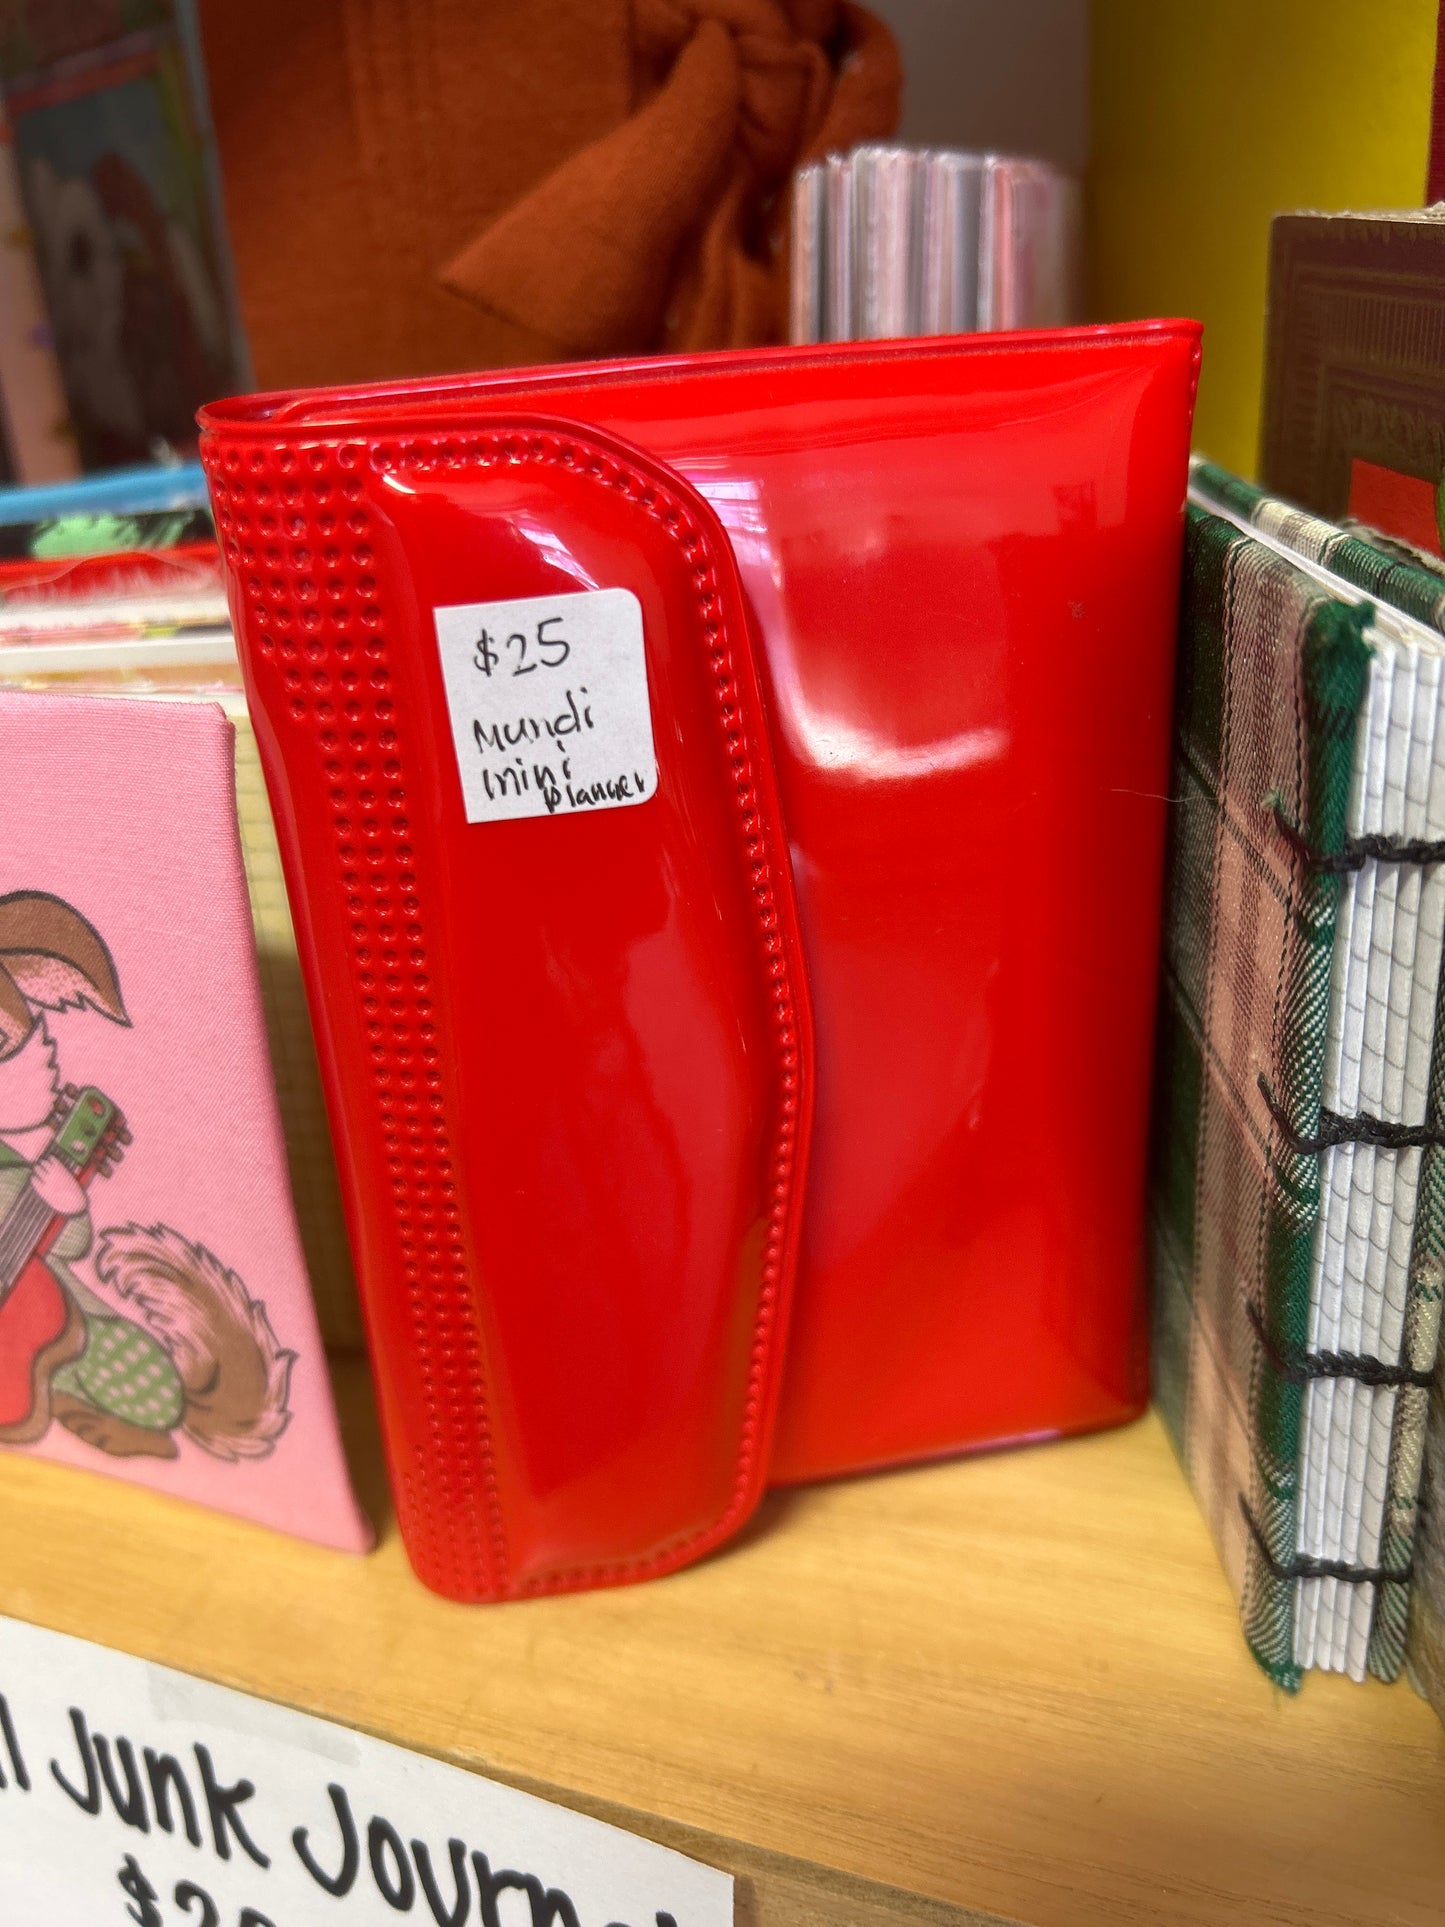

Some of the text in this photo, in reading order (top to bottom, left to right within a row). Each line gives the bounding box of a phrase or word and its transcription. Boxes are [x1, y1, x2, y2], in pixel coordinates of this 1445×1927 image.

[473, 616, 571, 678] $25
[473, 686, 595, 754] Mundi
[482, 739, 572, 801] mini
[542, 771, 645, 814] planner
[49, 1705, 272, 1870] Junk
[291, 1782, 681, 1927] Journ
[116, 1852, 279, 1927] $2
